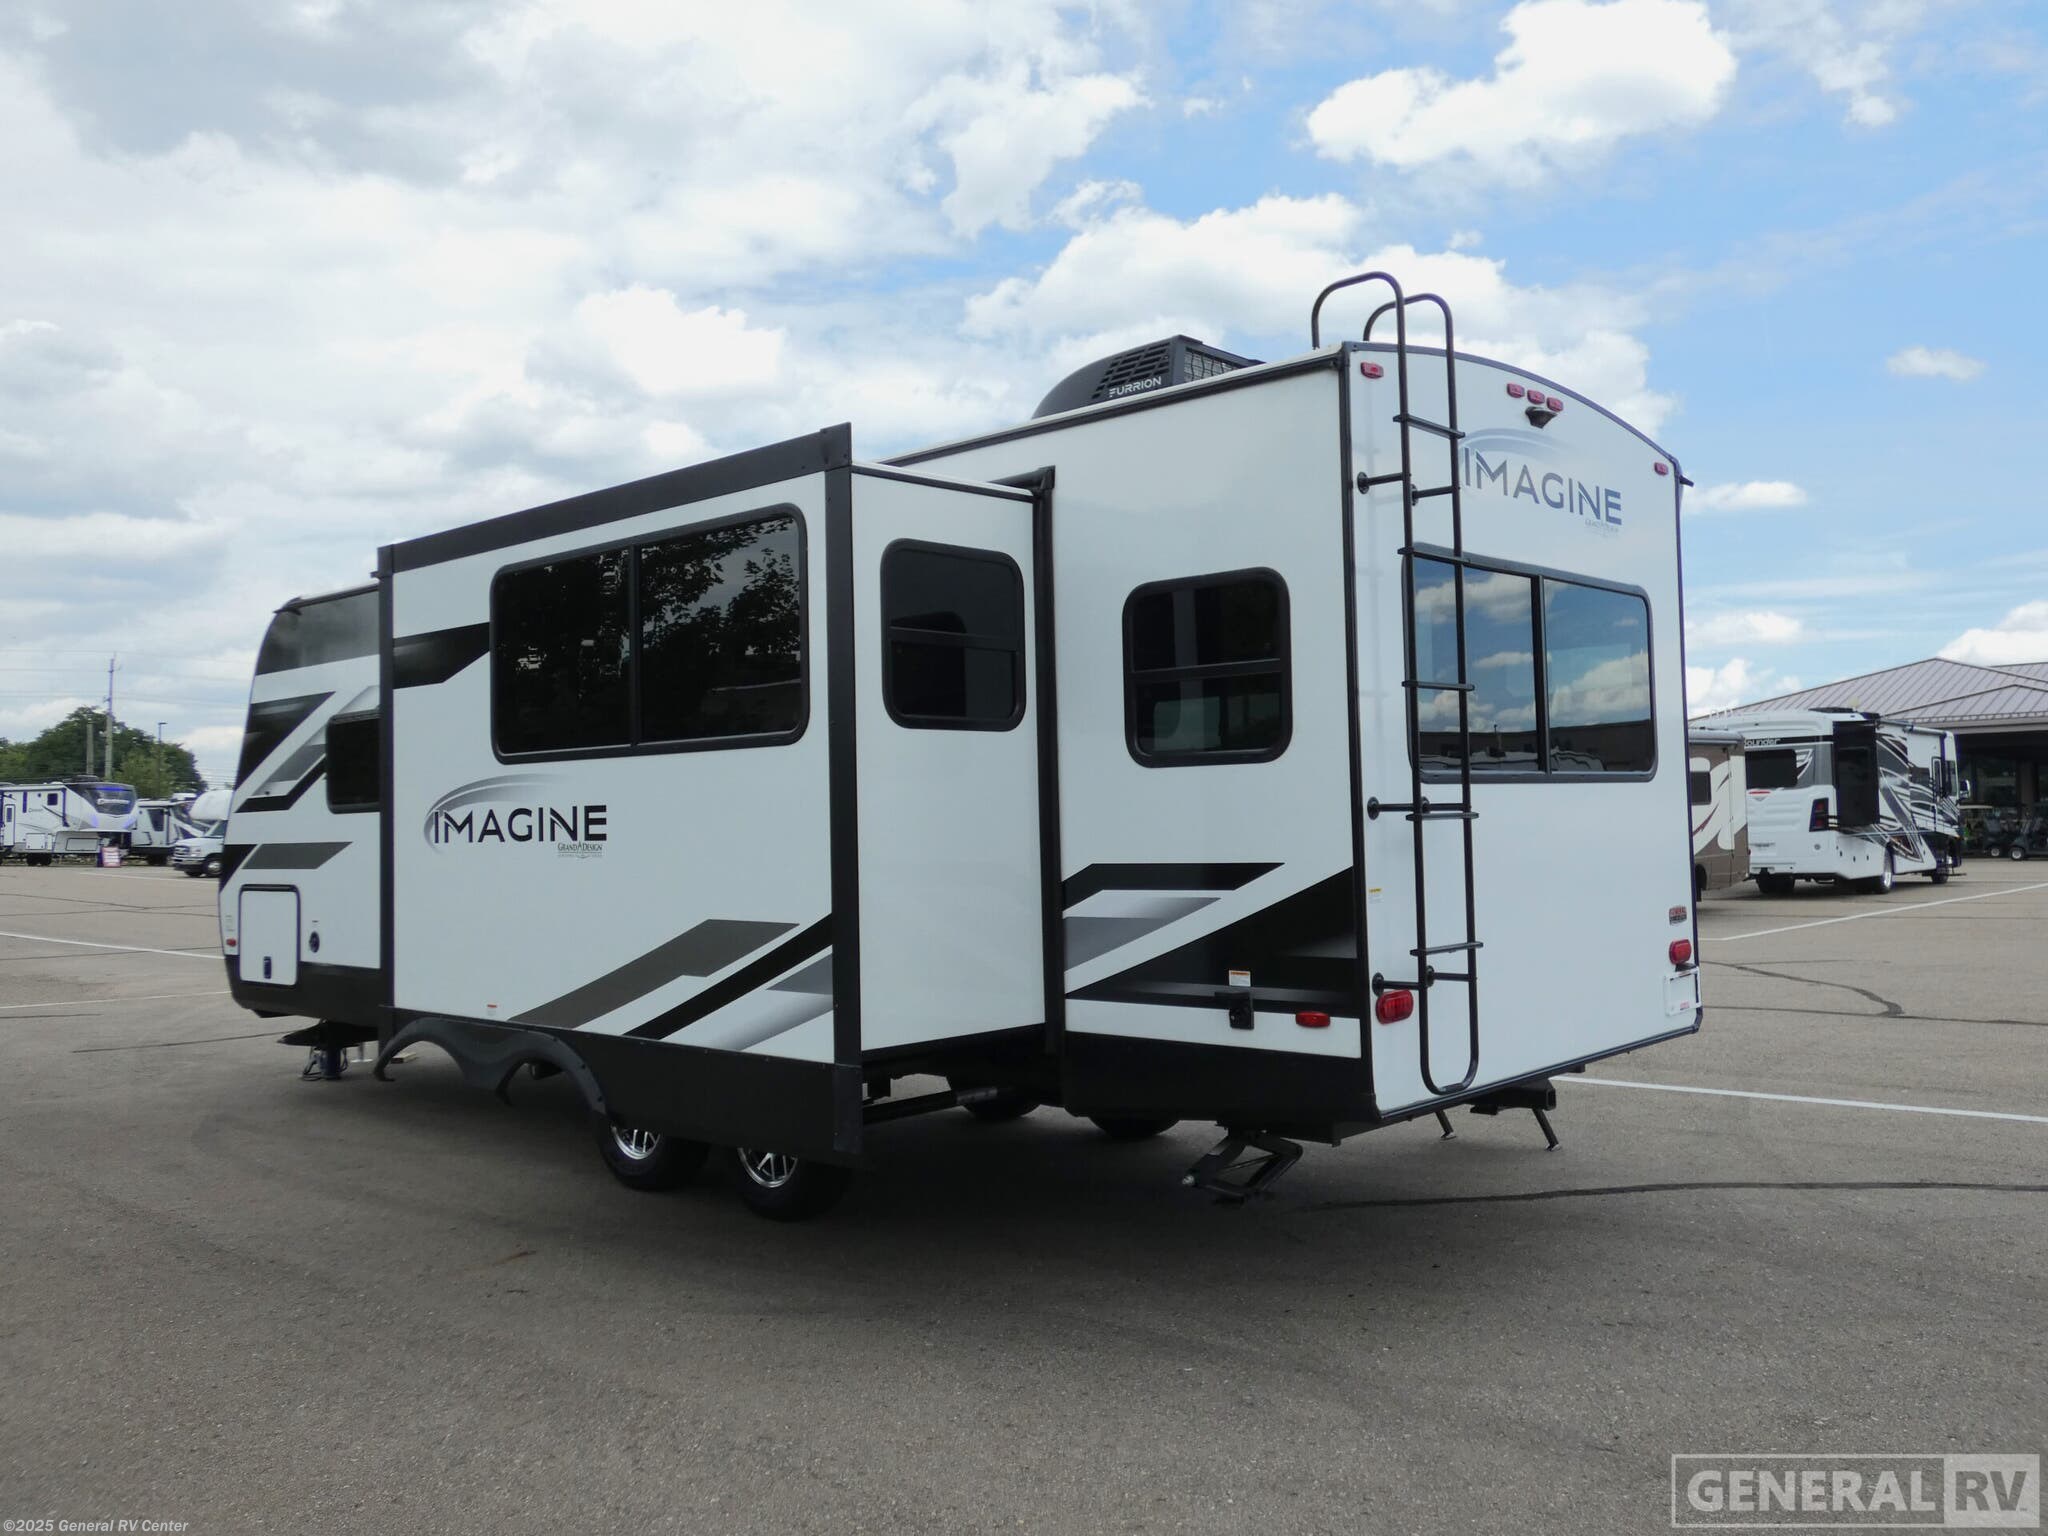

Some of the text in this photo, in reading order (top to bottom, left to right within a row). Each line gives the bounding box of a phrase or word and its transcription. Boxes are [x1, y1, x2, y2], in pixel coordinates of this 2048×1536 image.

[1109, 375, 1162, 398] FURRION
[1463, 446, 1622, 526] IMAGINE
[433, 804, 608, 844] IMAGINE
